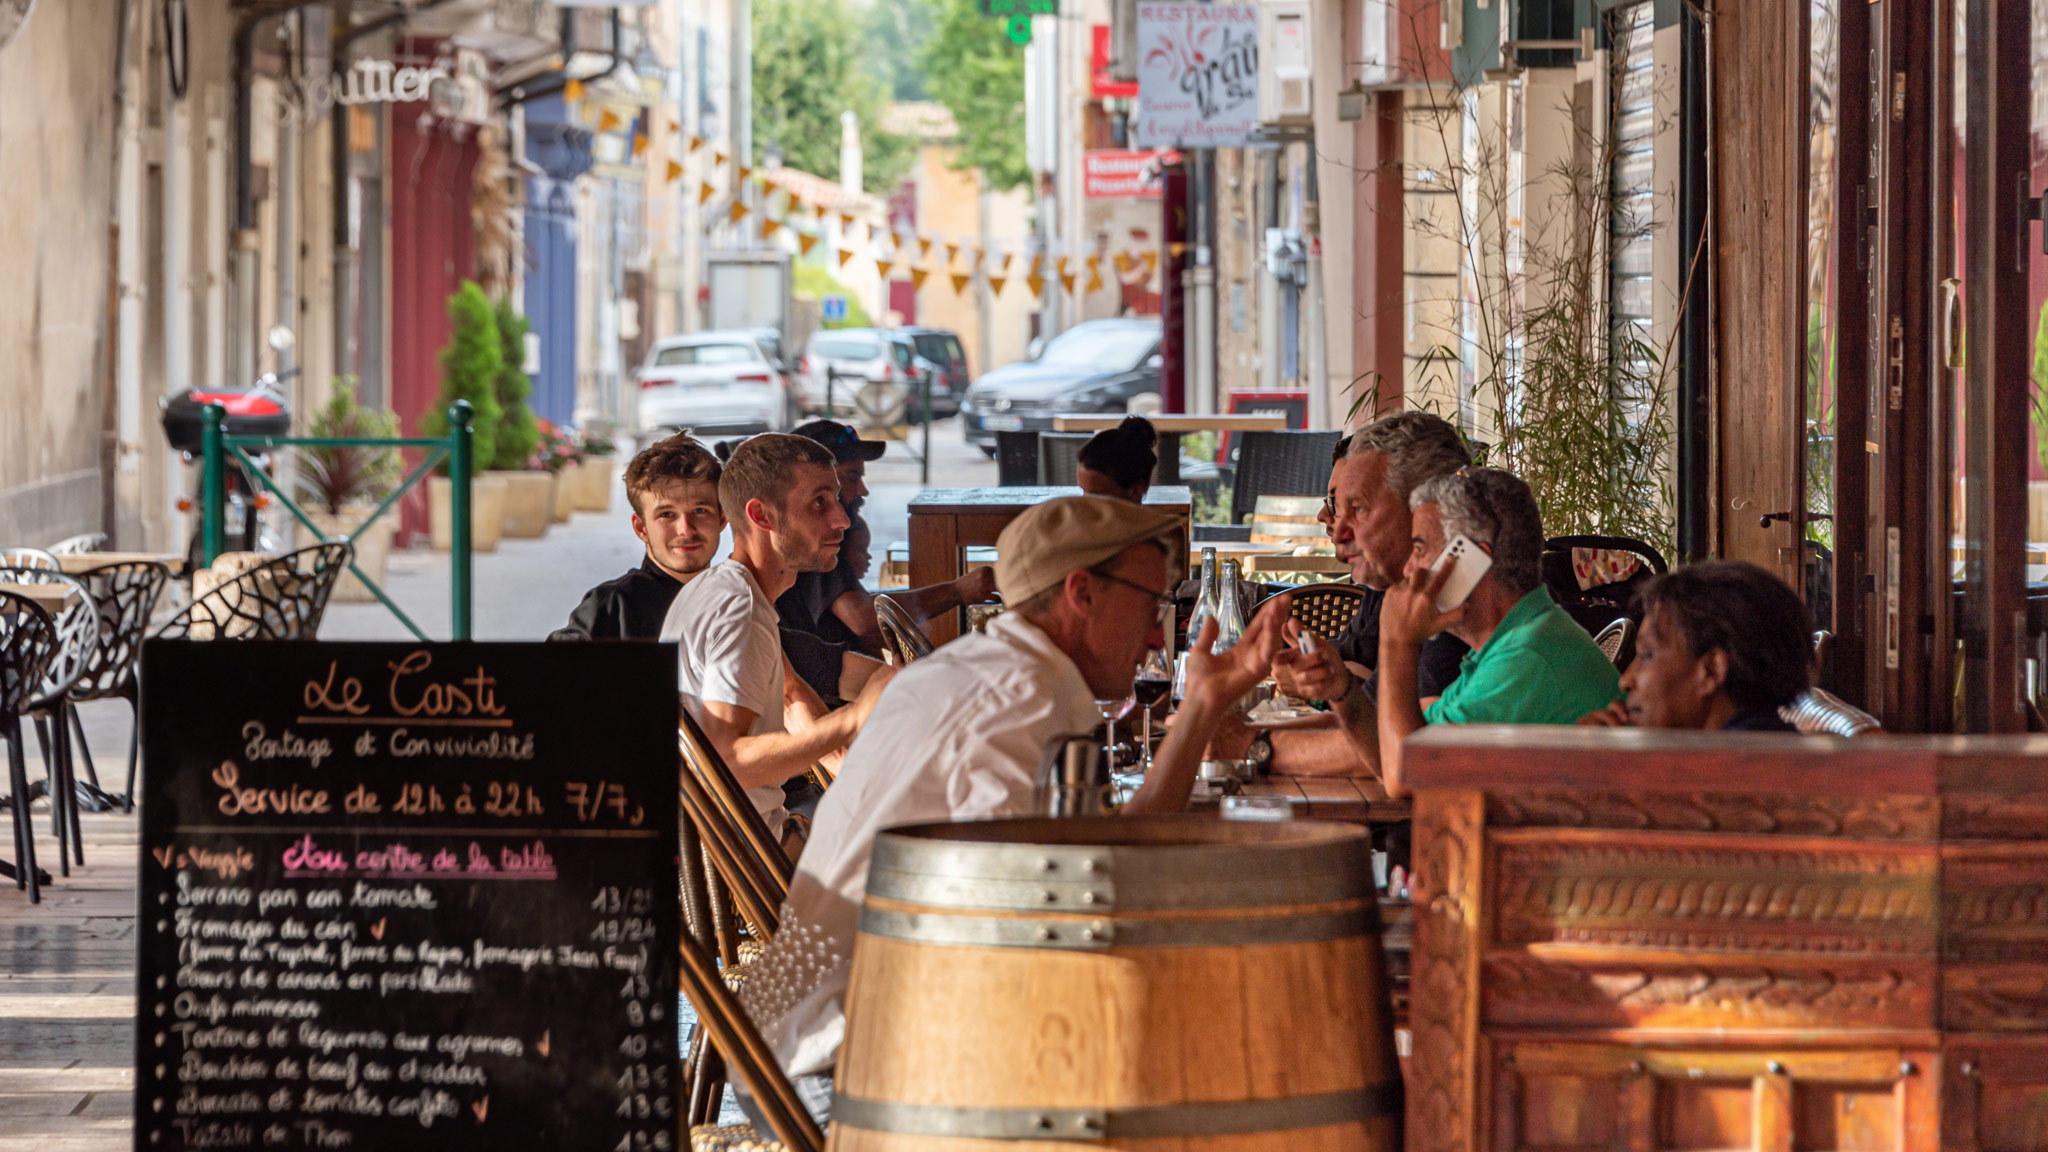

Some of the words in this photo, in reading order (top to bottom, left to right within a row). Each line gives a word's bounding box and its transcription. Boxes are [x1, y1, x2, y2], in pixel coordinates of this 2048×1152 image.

[304, 659, 372, 715] Le
[387, 650, 507, 716] Casti
[242, 720, 333, 768] Partage
[354, 729, 377, 757] et
[390, 728, 535, 760] Convivialité
[211, 760, 332, 817] Service
[345, 783, 382, 814] de
[392, 782, 446, 815] 12h
[454, 781, 477, 815] à
[484, 781, 545, 817] 22h
[355, 843, 428, 871] centre
[432, 847, 461, 872] de
[466, 841, 497, 873] la
[501, 839, 556, 872] table
[176, 870, 252, 907] Serrano
[258, 887, 299, 917] pan
[306, 888, 344, 909] con
[350, 879, 438, 910] tomate
[175, 908, 275, 948] Fromages
[280, 915, 309, 940] du
[240, 965, 270, 989] de
[276, 969, 343, 990] canard
[347, 972, 374, 990] en
[380, 964, 473, 999] persillade
[171, 1021, 261, 1049] Tartare
[266, 1024, 290, 1047] de
[393, 1031, 430, 1052] aux
[436, 1034, 524, 1062] agrumes
[275, 1055, 300, 1080] de
[362, 1060, 392, 1081] au
[267, 1086, 292, 1112] et
[263, 1122, 289, 1145] de
